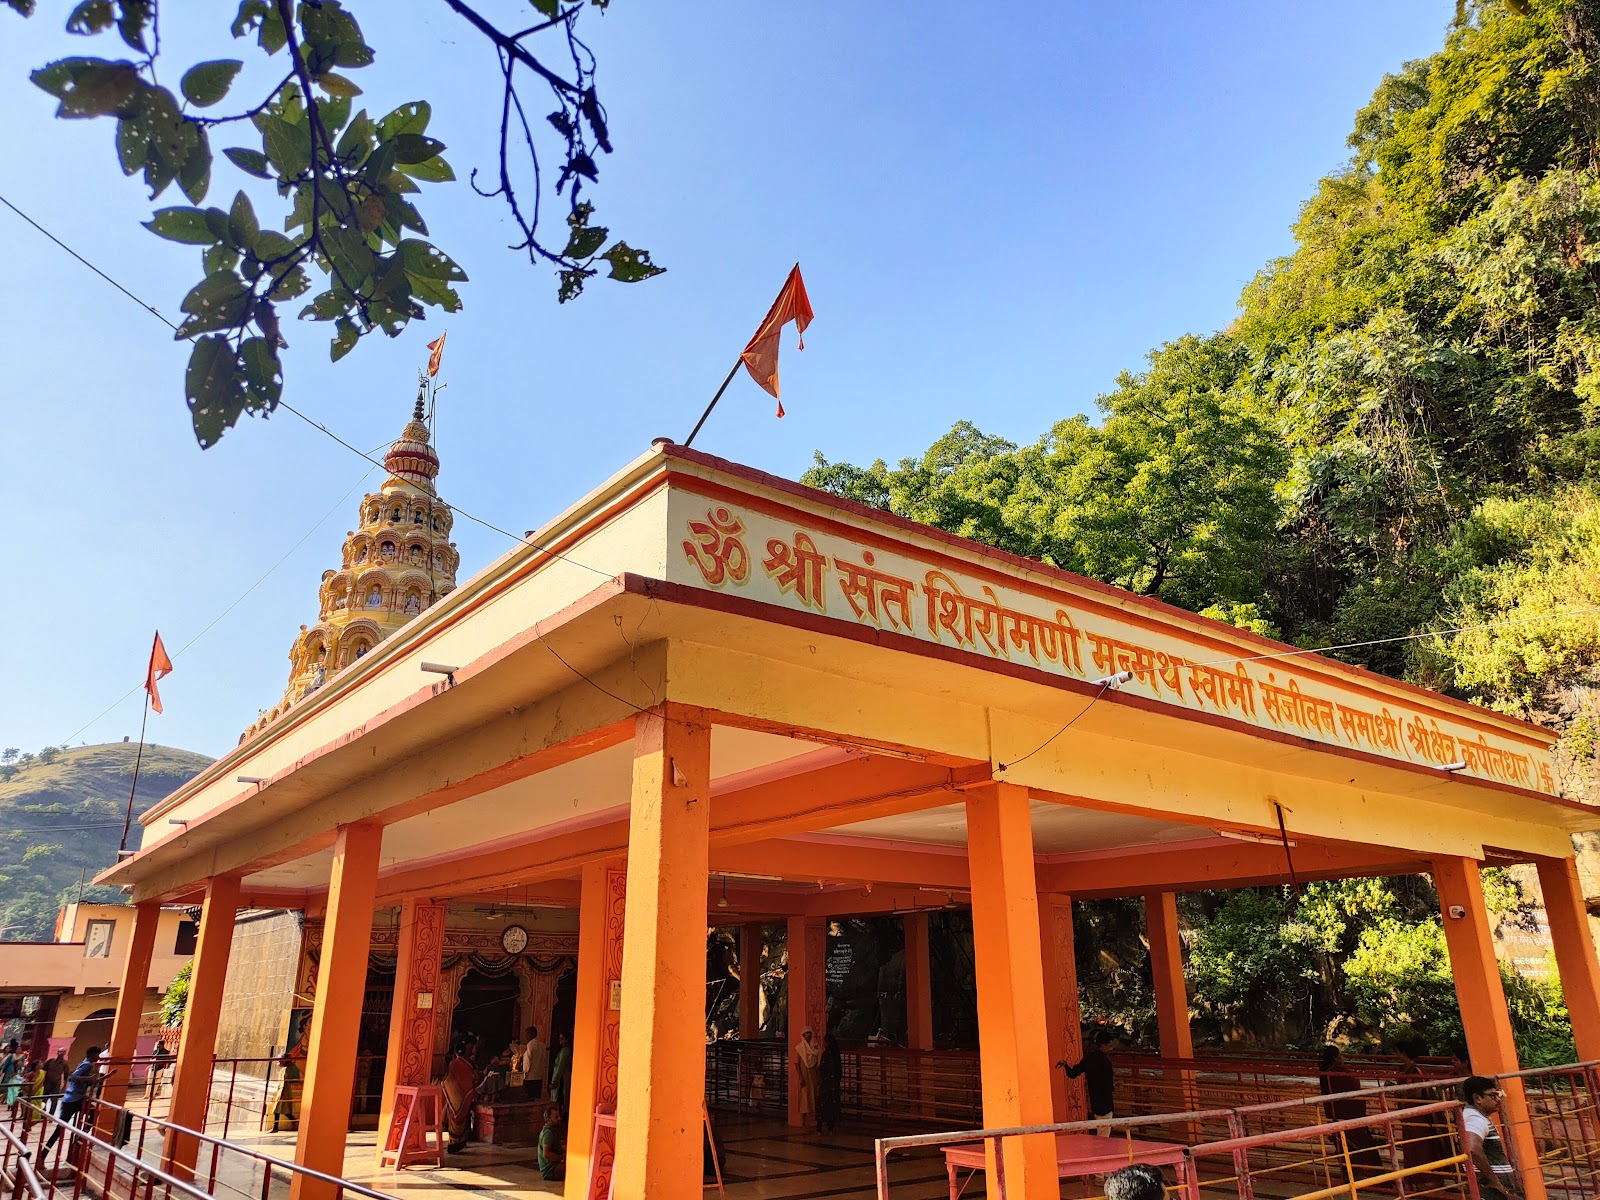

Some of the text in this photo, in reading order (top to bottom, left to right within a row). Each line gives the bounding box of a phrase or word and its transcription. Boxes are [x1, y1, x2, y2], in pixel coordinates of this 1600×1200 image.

[682, 507, 750, 589] ॐ
[762, 530, 830, 614] श्री
[833, 550, 918, 635] संत
[920, 570, 1087, 677] शिरोमणी
[1184, 658, 1258, 722] स्वामी
[1257, 672, 1340, 742] संजीवन
[1335, 702, 1402, 756] समाधी
